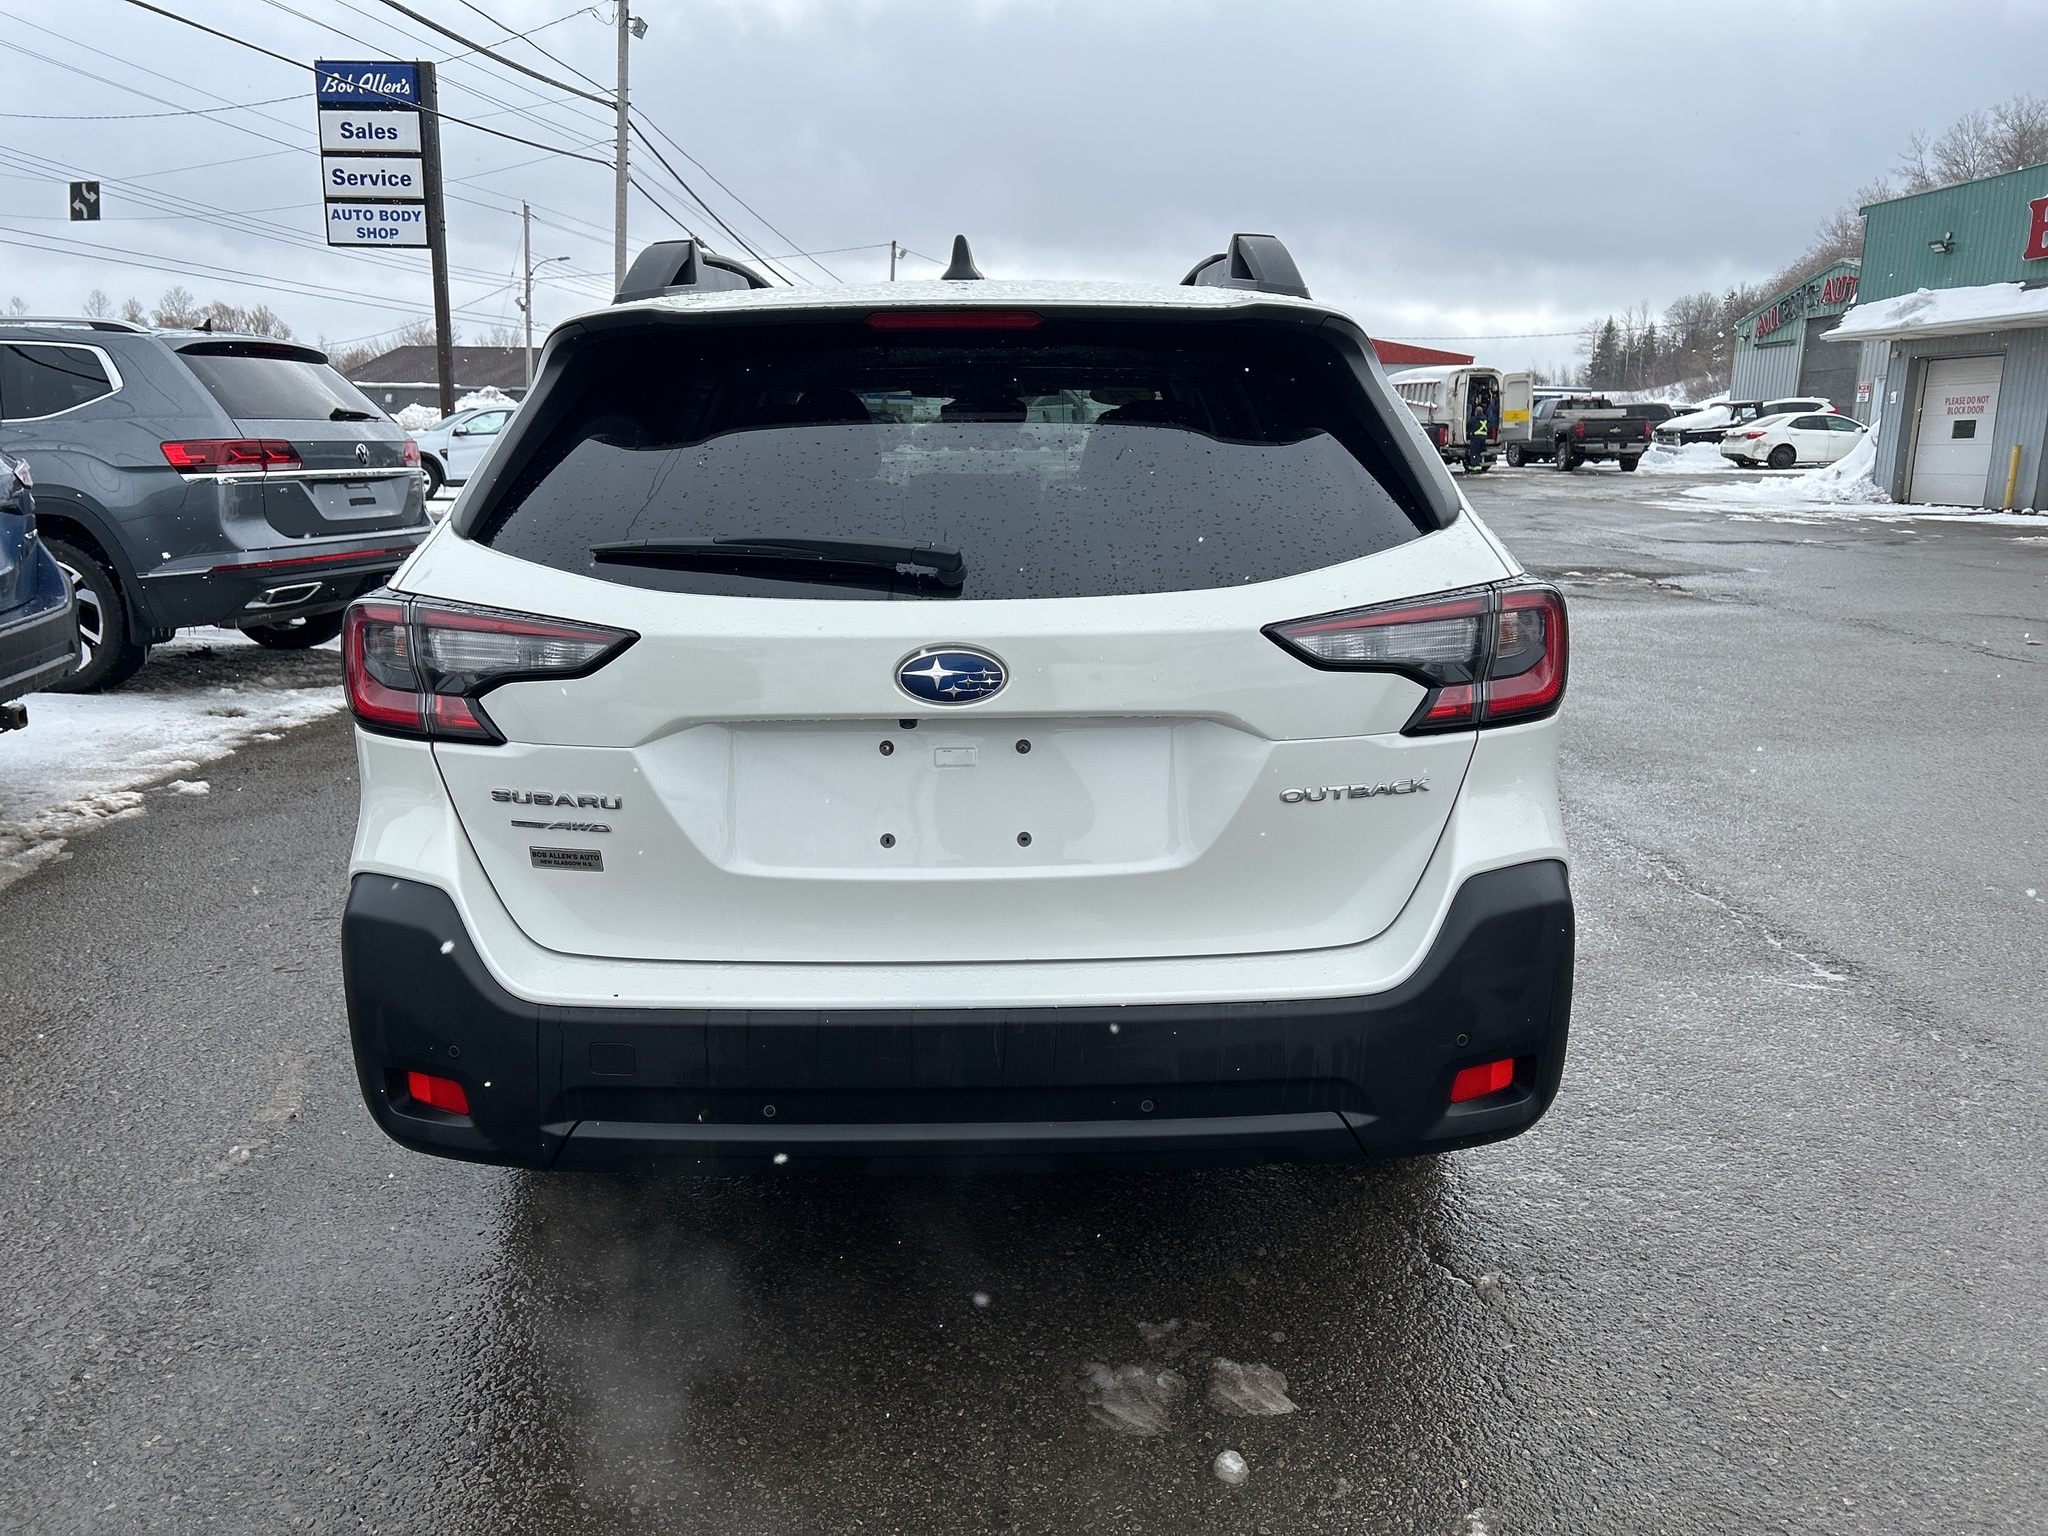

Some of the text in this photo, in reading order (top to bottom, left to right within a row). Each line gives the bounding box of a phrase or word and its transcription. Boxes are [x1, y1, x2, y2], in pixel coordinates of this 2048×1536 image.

[321, 72, 411, 95] Bob Allen's
[340, 121, 398, 140] Sales
[331, 168, 412, 187] Service
[331, 209, 422, 222] AUTO BODY
[356, 227, 399, 240] SHOP
[1821, 275, 1860, 304] AUT
[1945, 395, 1990, 405] PLEASE DO NOT
[1947, 405, 1985, 415] BLOCK DOOR
[1279, 776, 1430, 803] OUTBACK
[491, 788, 623, 810] SUBARU
[548, 820, 613, 833] AWD
[549, 852, 578, 860] ALLEN'S
